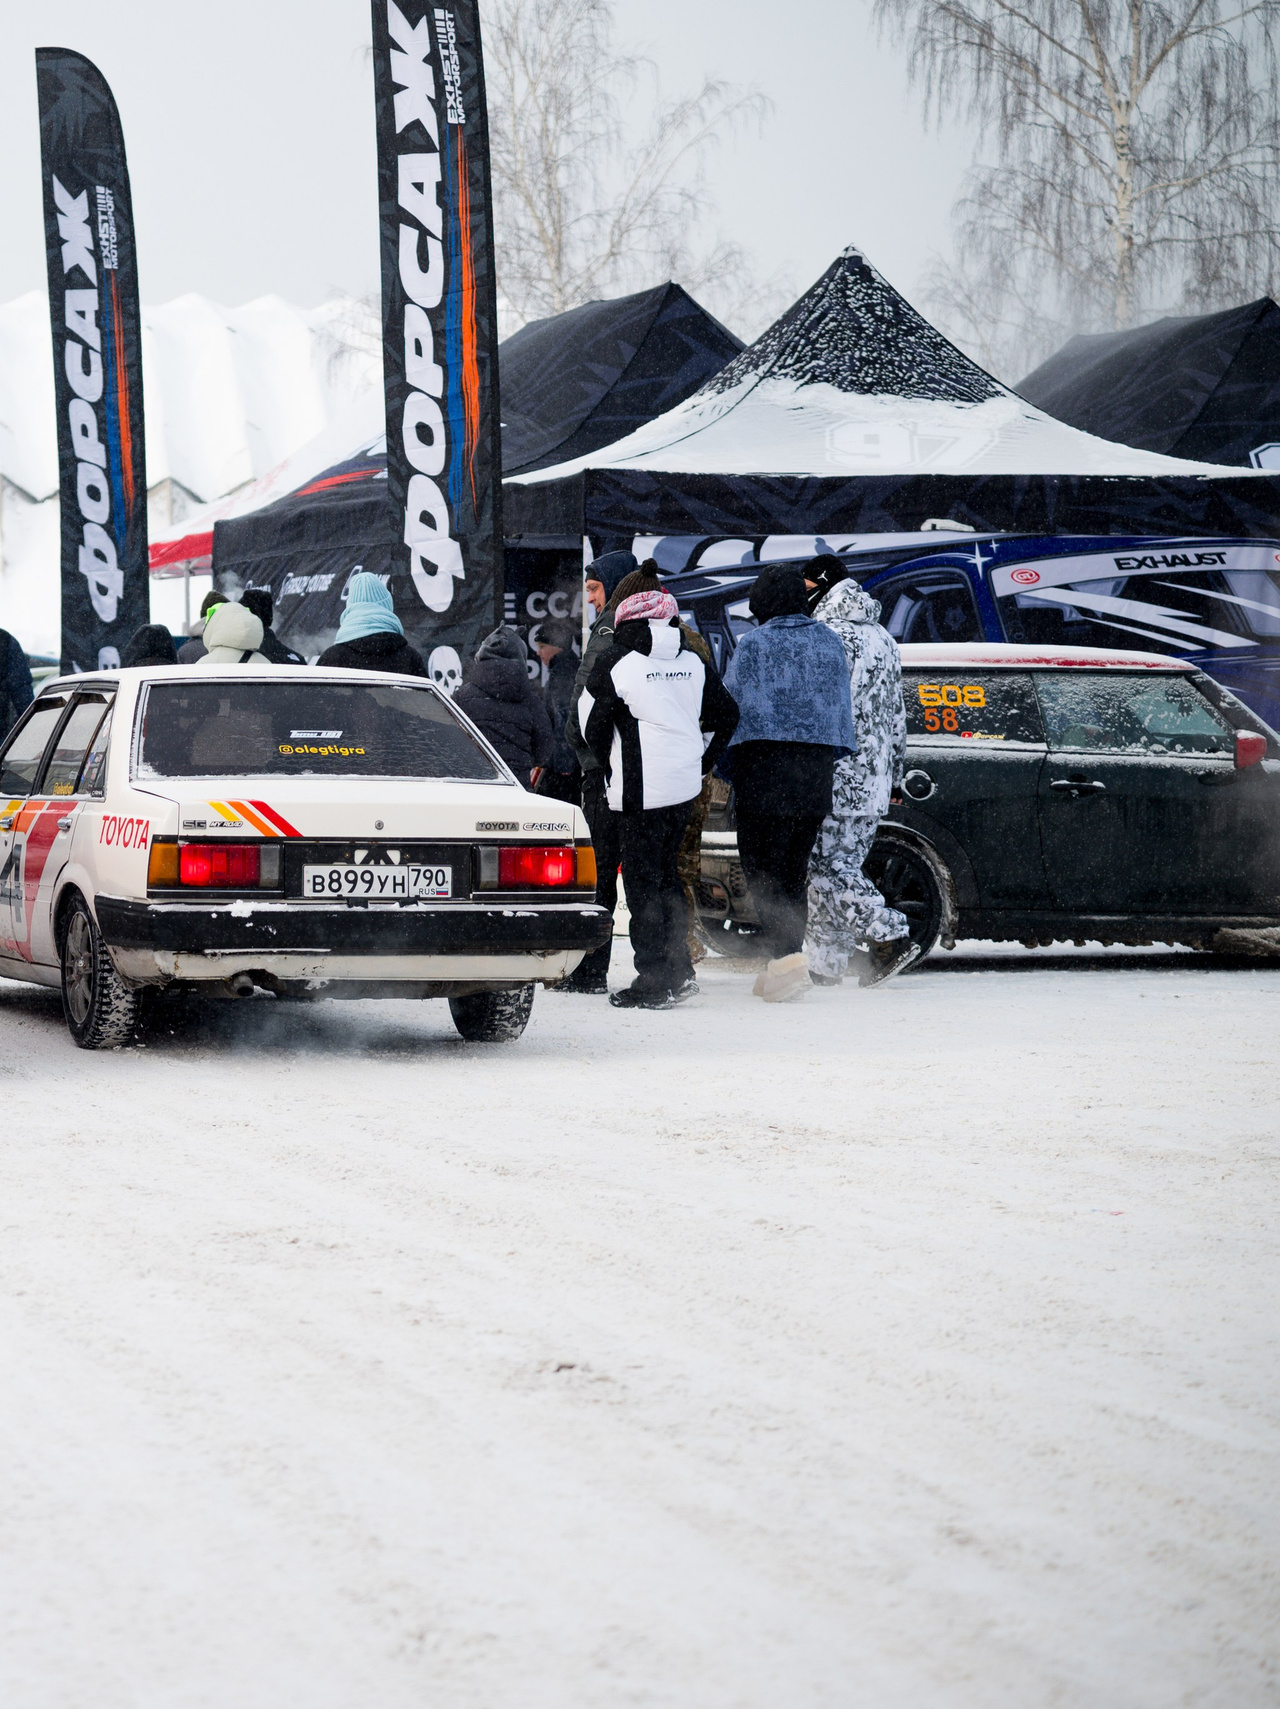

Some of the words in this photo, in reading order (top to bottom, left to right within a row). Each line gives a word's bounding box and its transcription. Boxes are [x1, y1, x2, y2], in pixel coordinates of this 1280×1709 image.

[445, 10, 466, 124] MOTORSPORT
[106, 187, 119, 269] MOTORSPORT
[387, 0, 466, 613] ФОРСАЖ
[52, 174, 124, 623] ФОРСАЖ
[1113, 552, 1227, 571] EXHAUST
[918, 685, 986, 707] 508
[924, 708, 958, 731] 58
[99, 815, 150, 850] TOYOTA
[479, 822, 517, 830] TOYOTA
[523, 823, 571, 831] CARINA
[312, 869, 406, 894] В899УН
[411, 868, 446, 887] 790
